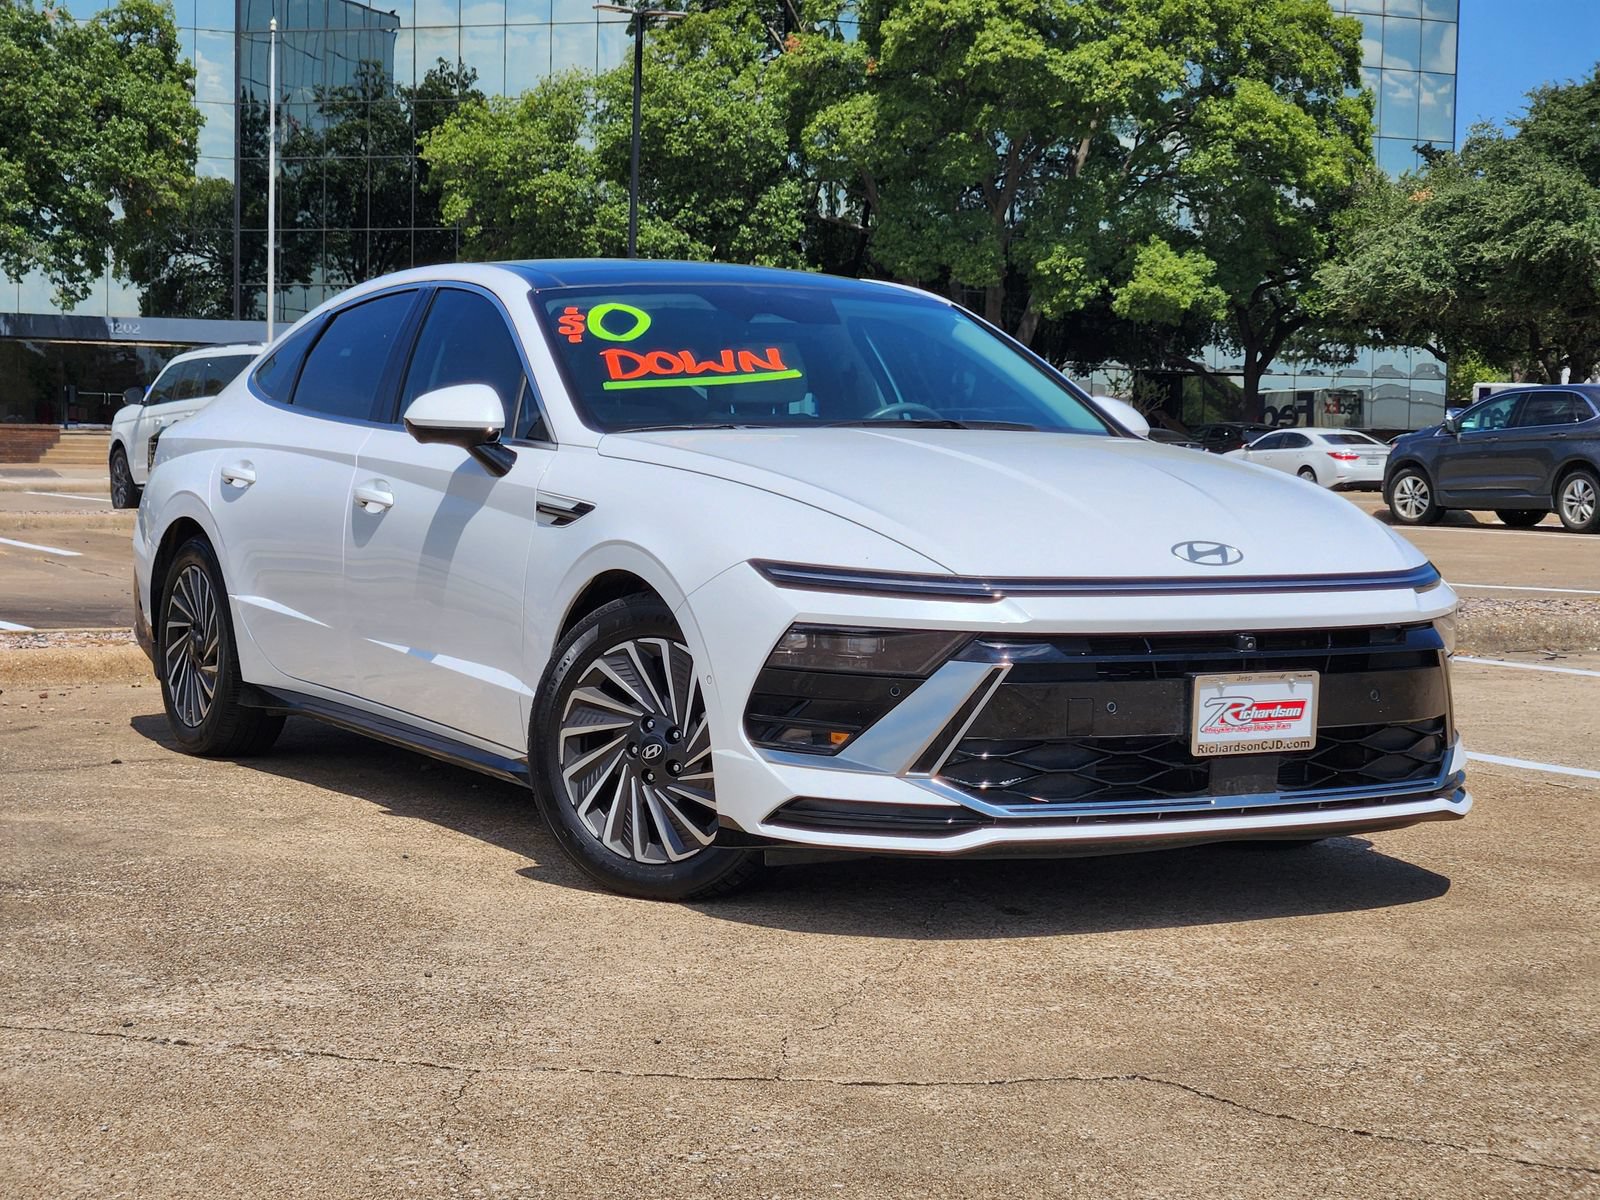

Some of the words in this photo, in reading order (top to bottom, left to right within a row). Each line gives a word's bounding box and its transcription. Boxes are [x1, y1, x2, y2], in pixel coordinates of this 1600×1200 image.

[109, 322, 141, 335] 1202
[600, 348, 788, 380] DOWN
[1200, 696, 1302, 733] Richardson
[1197, 739, 1310, 754] RichardsonCJD.com
